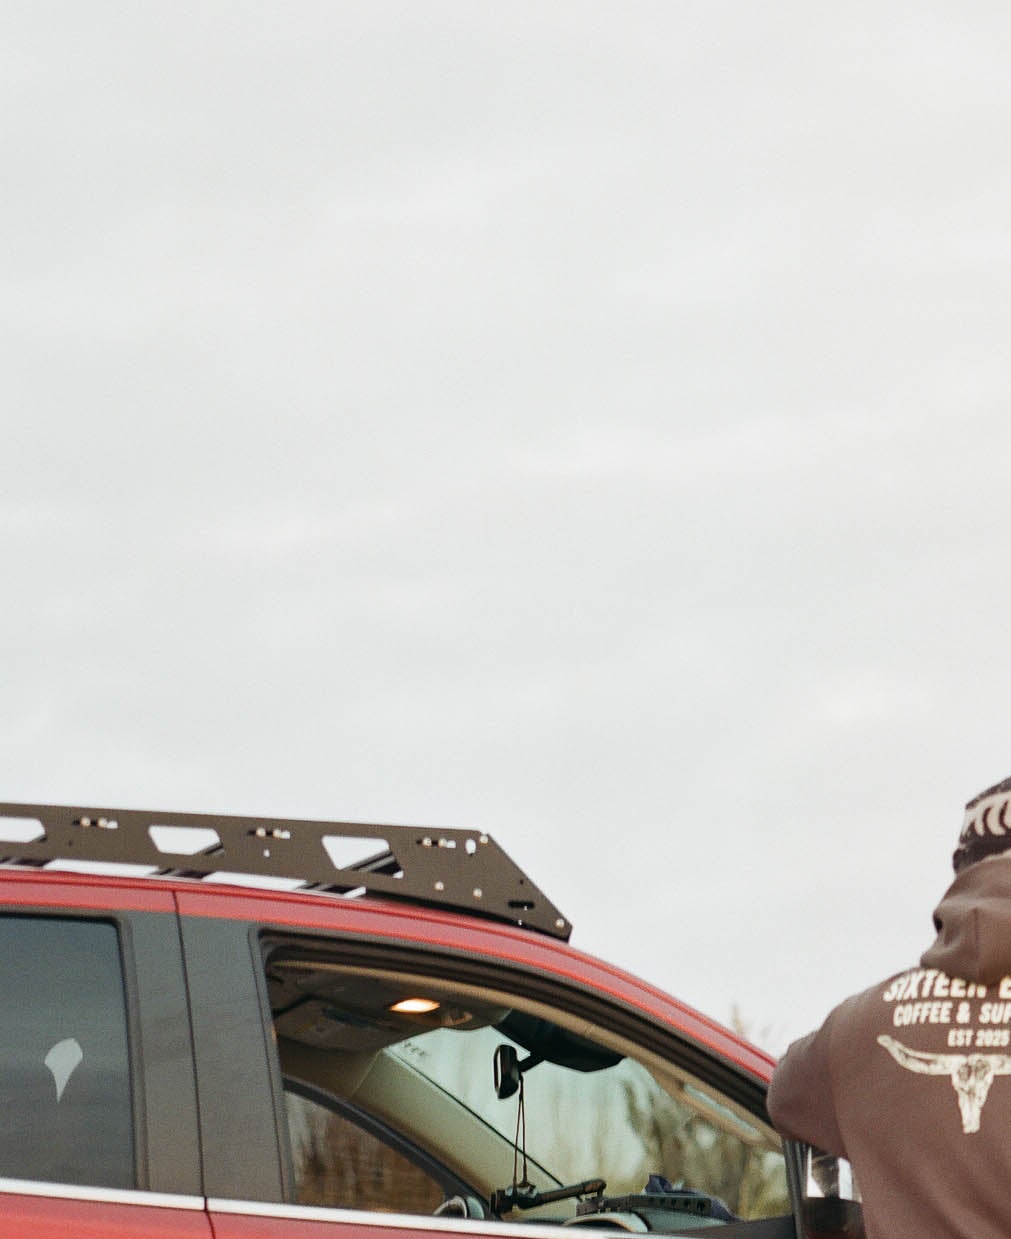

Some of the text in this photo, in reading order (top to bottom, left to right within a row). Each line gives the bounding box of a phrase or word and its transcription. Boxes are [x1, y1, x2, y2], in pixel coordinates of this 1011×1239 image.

[893, 1001, 953, 1027] COFFEE
[956, 1001, 970, 1024] &
[947, 1029, 1010, 1047] EST 2025
